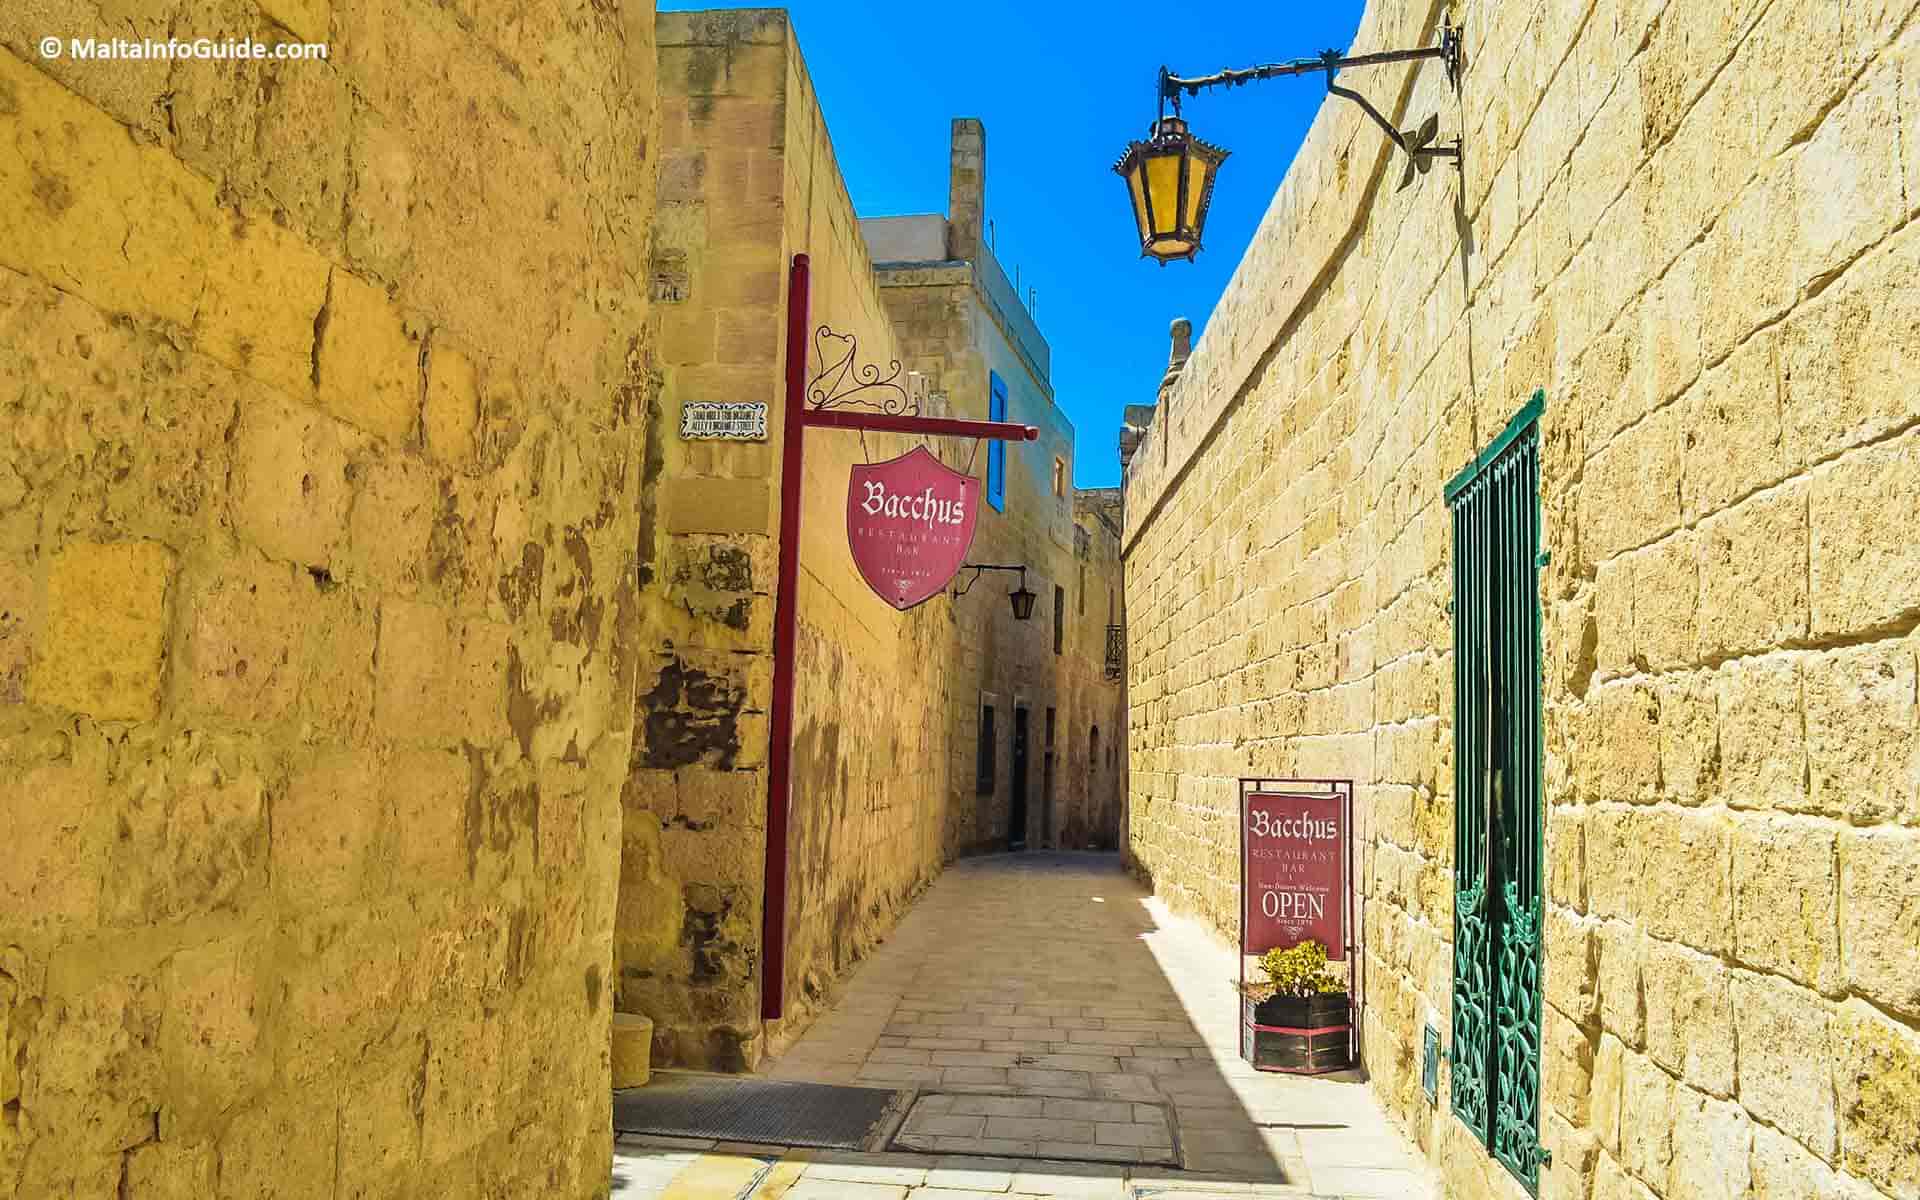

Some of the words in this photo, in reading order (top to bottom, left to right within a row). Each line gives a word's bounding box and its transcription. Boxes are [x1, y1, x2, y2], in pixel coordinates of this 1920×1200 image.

[862, 480, 965, 529] Bacchus
[858, 527, 962, 545] RESTAURANT
[1250, 809, 1337, 846] Bacchus
[1252, 848, 1336, 862] RESTAURANT
[1282, 863, 1306, 874] BAR
[1262, 890, 1326, 921] OPEN
